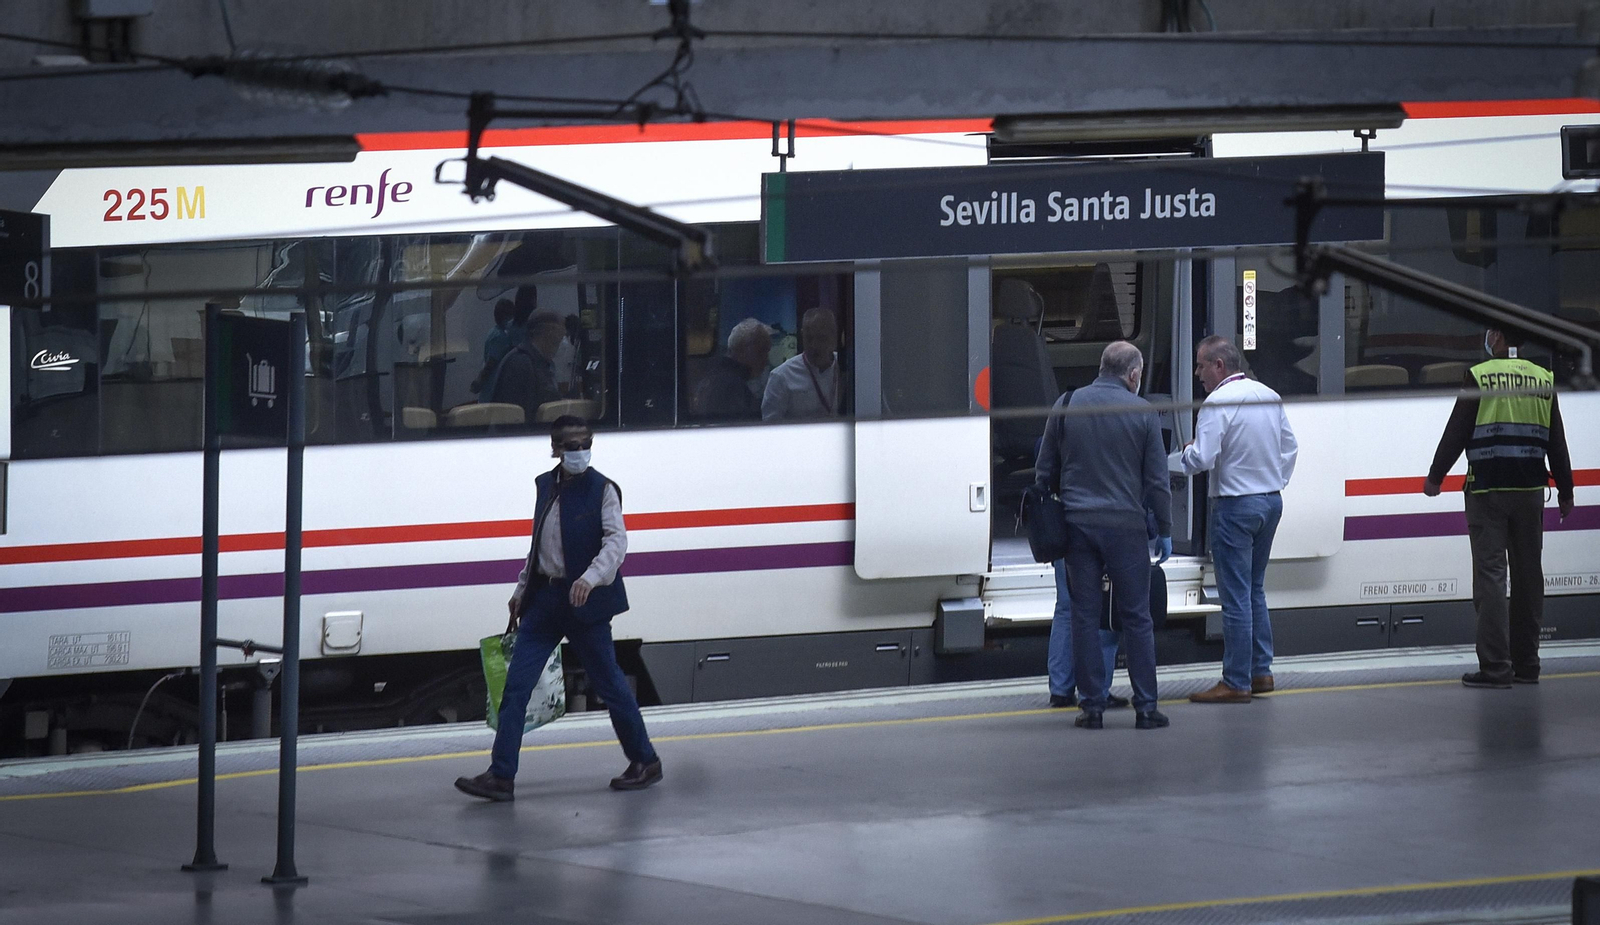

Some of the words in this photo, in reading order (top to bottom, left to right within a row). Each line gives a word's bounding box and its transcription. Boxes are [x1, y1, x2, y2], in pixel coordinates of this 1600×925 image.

[305, 168, 413, 219] renfe
[940, 191, 1036, 226] Sevilla
[1047, 190, 1130, 222] Santa
[1140, 188, 1217, 219] Justa
[24, 261, 39, 300] 8
[1480, 373, 1551, 400] SEGURIDAD
[1363, 585, 1389, 596] FRENO
[1393, 583, 1427, 594] SERVICIO
[1438, 582, 1447, 592] 62
